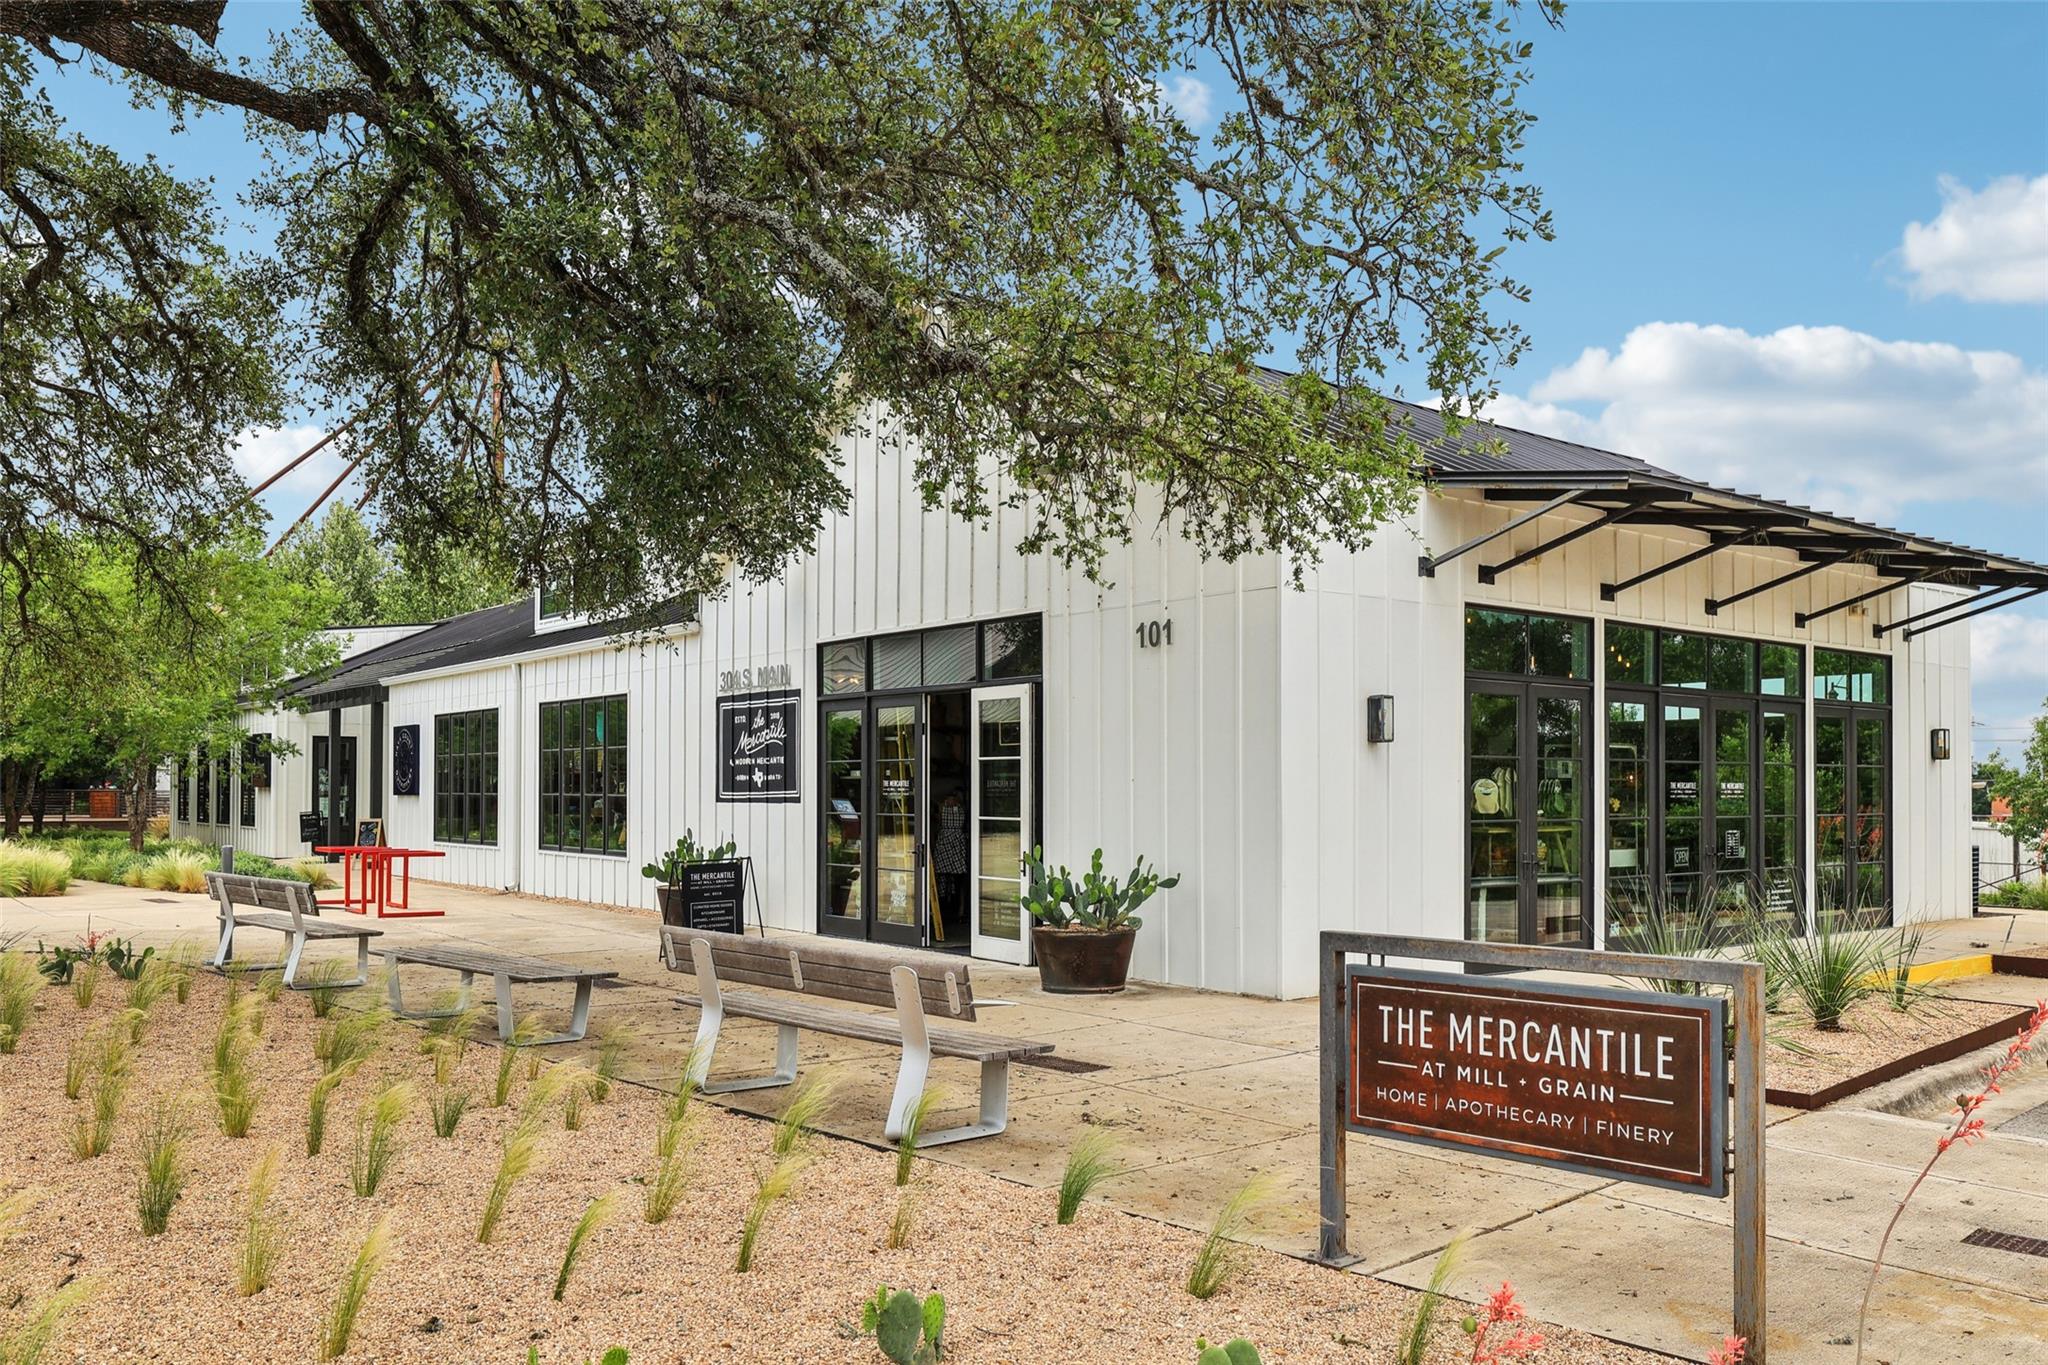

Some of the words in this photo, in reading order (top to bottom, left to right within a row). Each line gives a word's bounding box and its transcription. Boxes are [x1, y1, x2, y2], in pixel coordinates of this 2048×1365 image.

[1135, 618, 1173, 649] 101
[734, 717, 787, 755] Mercantile
[751, 708, 766, 730] the
[690, 873, 701, 881] THE
[702, 871, 735, 880] MERCANTILE
[1379, 1005, 1433, 1049] THE
[1450, 1012, 1674, 1080] MERCANTILE
[1421, 1060, 1446, 1079] AT
[1457, 1065, 1508, 1088] MILL
[1538, 1077, 1614, 1103] GRAIN
[1376, 1086, 1427, 1107] HOME
[1445, 1097, 1575, 1130] APOTHECARY
[1596, 1119, 1674, 1146] FINERY
